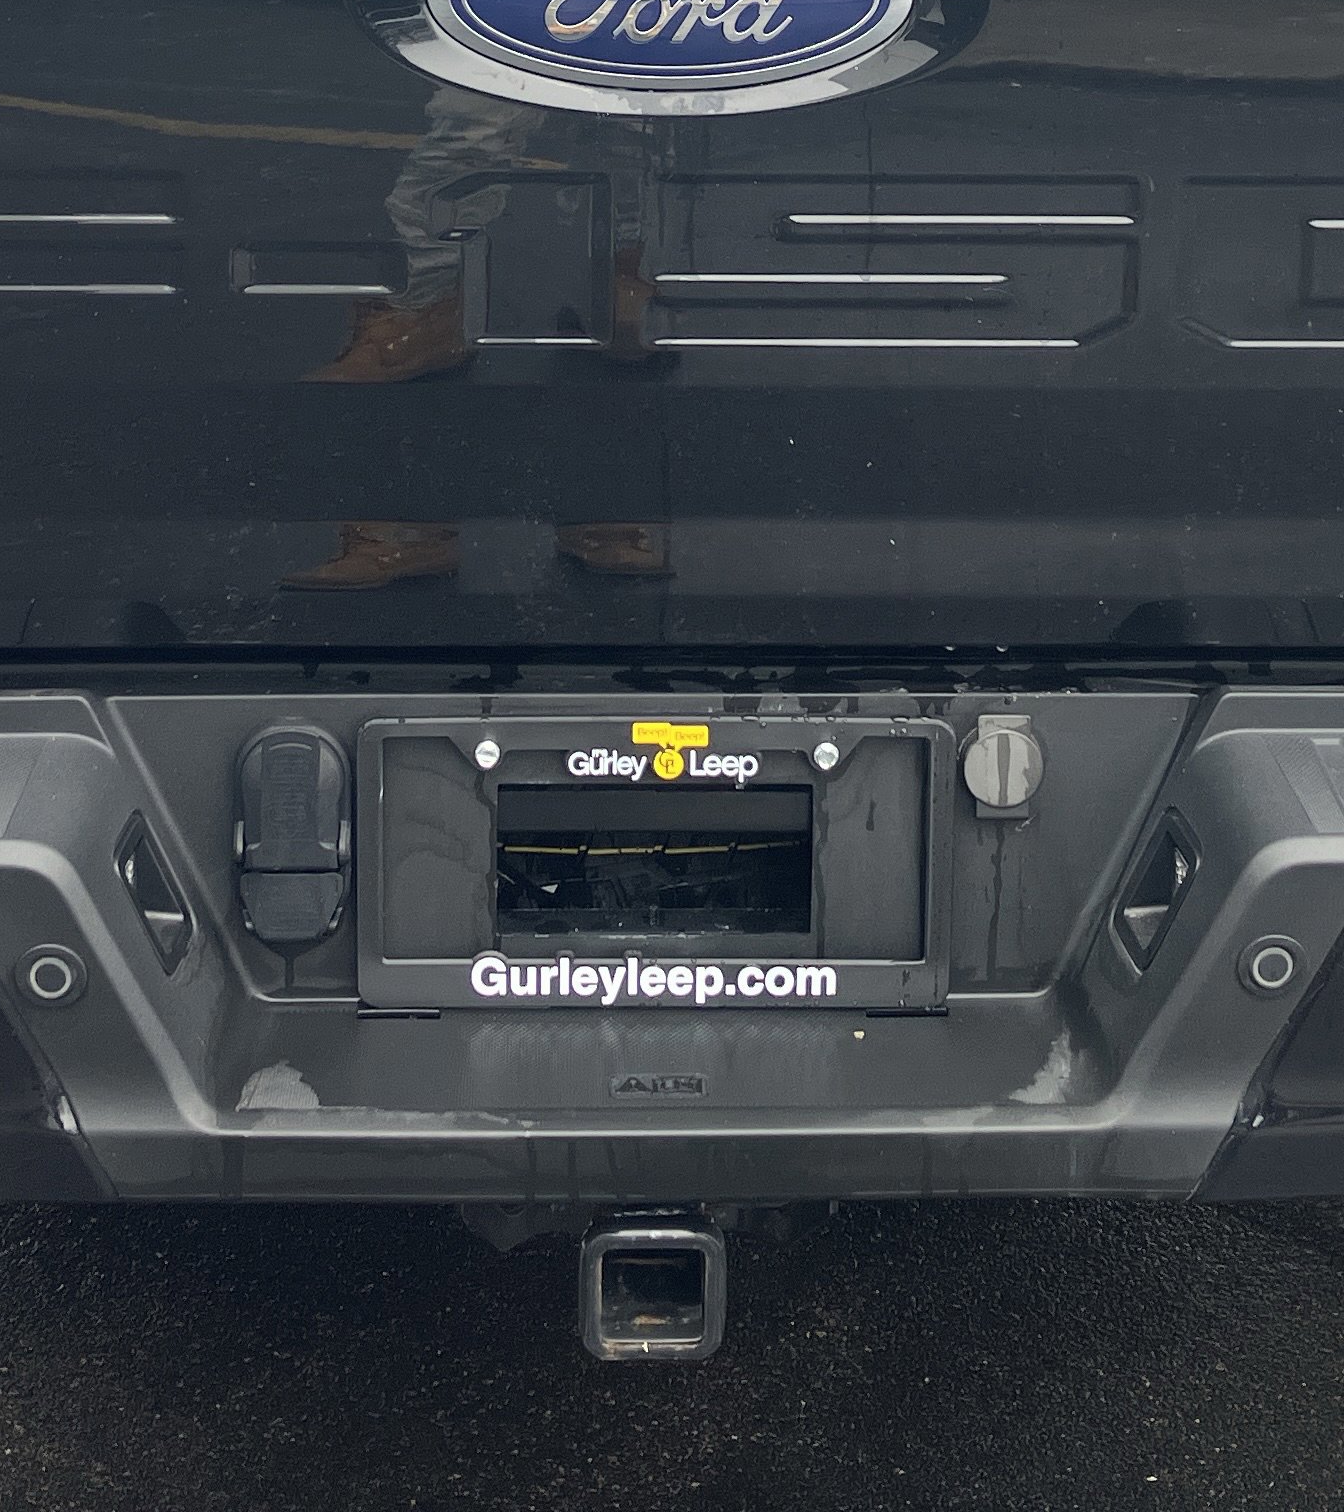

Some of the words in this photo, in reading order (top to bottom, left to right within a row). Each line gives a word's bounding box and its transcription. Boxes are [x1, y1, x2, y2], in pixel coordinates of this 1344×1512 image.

[637, 727, 669, 739] Beep!
[674, 731, 706, 743] Beep!
[567, 749, 648, 782] Gurley
[689, 749, 759, 783] Leep
[470, 956, 838, 1005] Gurleyleep.com
